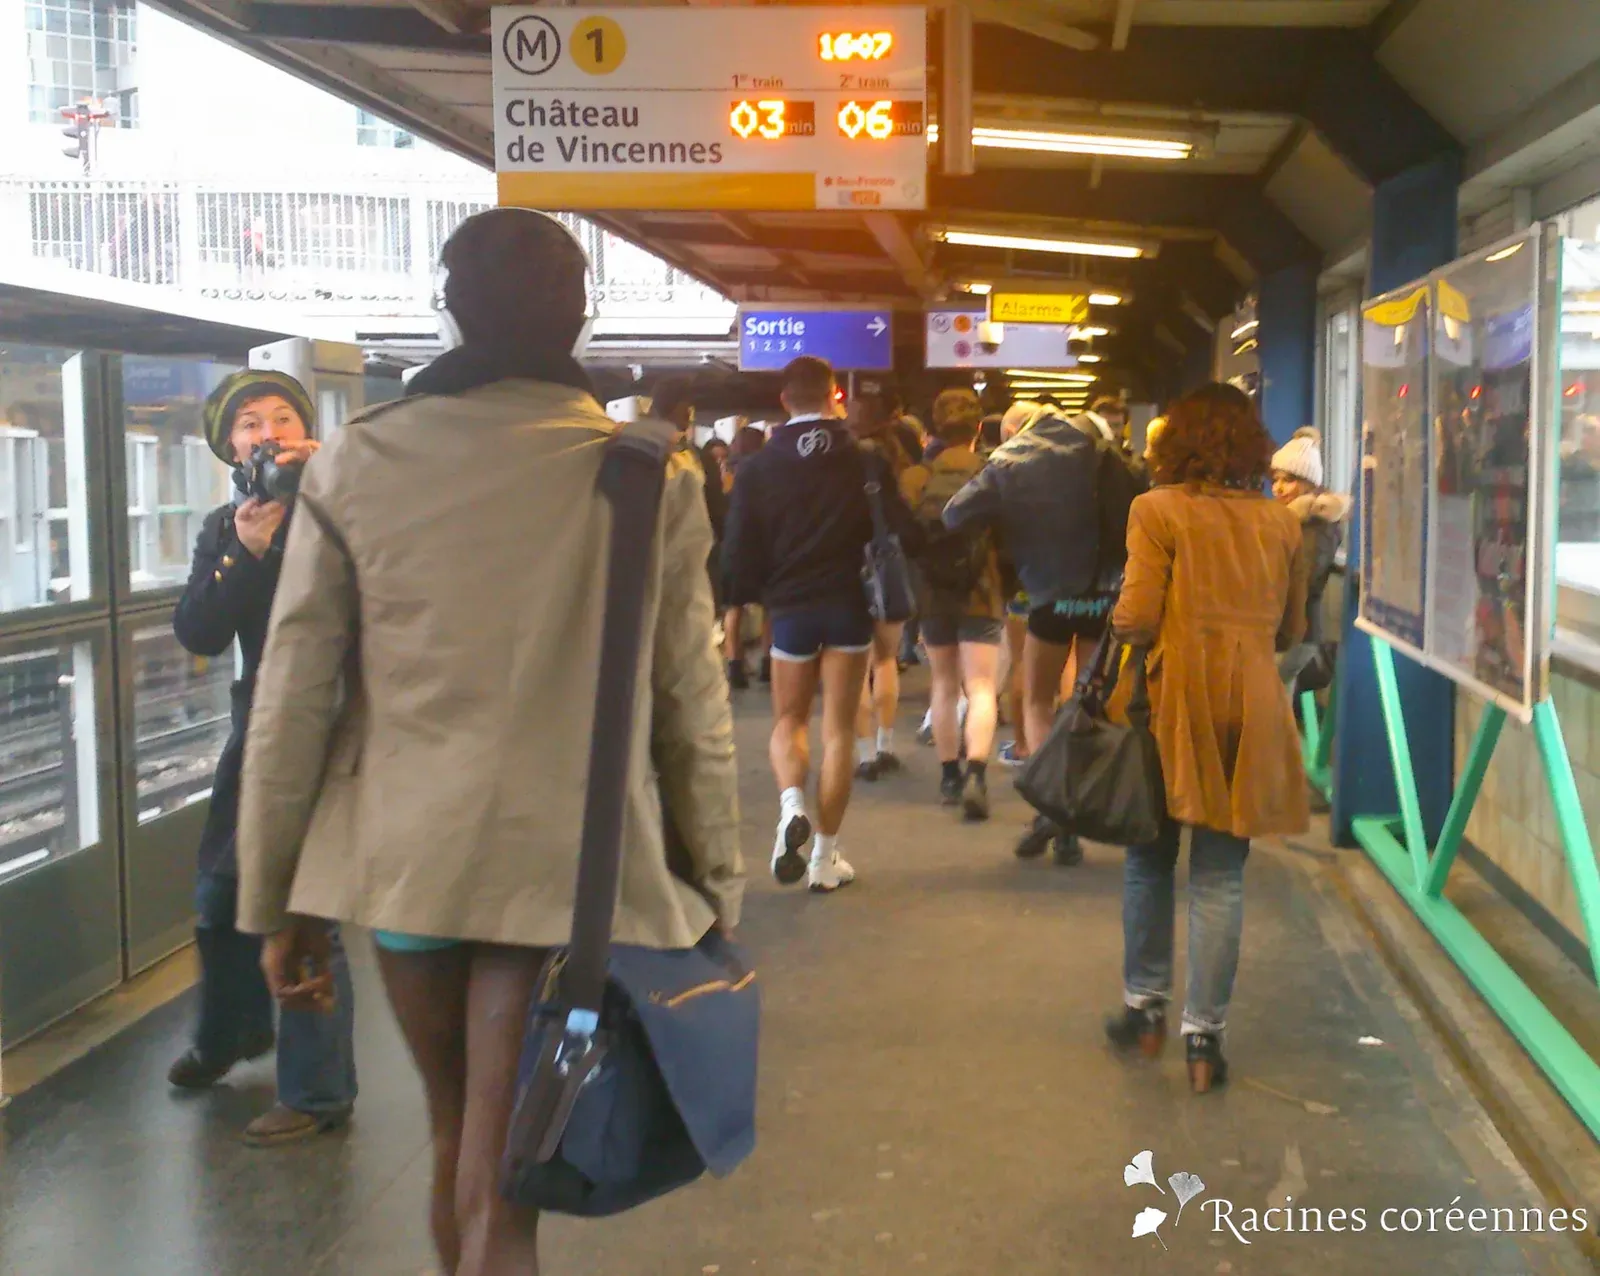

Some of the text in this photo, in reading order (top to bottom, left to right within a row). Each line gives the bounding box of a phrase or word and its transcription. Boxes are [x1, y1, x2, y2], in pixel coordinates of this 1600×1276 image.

[516, 28, 603, 63] M 1
[753, 76, 783, 88] train
[858, 77, 889, 88] train
[505, 99, 639, 127] Château
[730, 100, 785, 139] 03
[838, 100, 893, 139] 06
[507, 135, 723, 163] de Vincennes
[1001, 301, 1062, 317] Alarme
[745, 317, 806, 336] Sortie
[749, 340, 802, 351] 1 2 3 4
